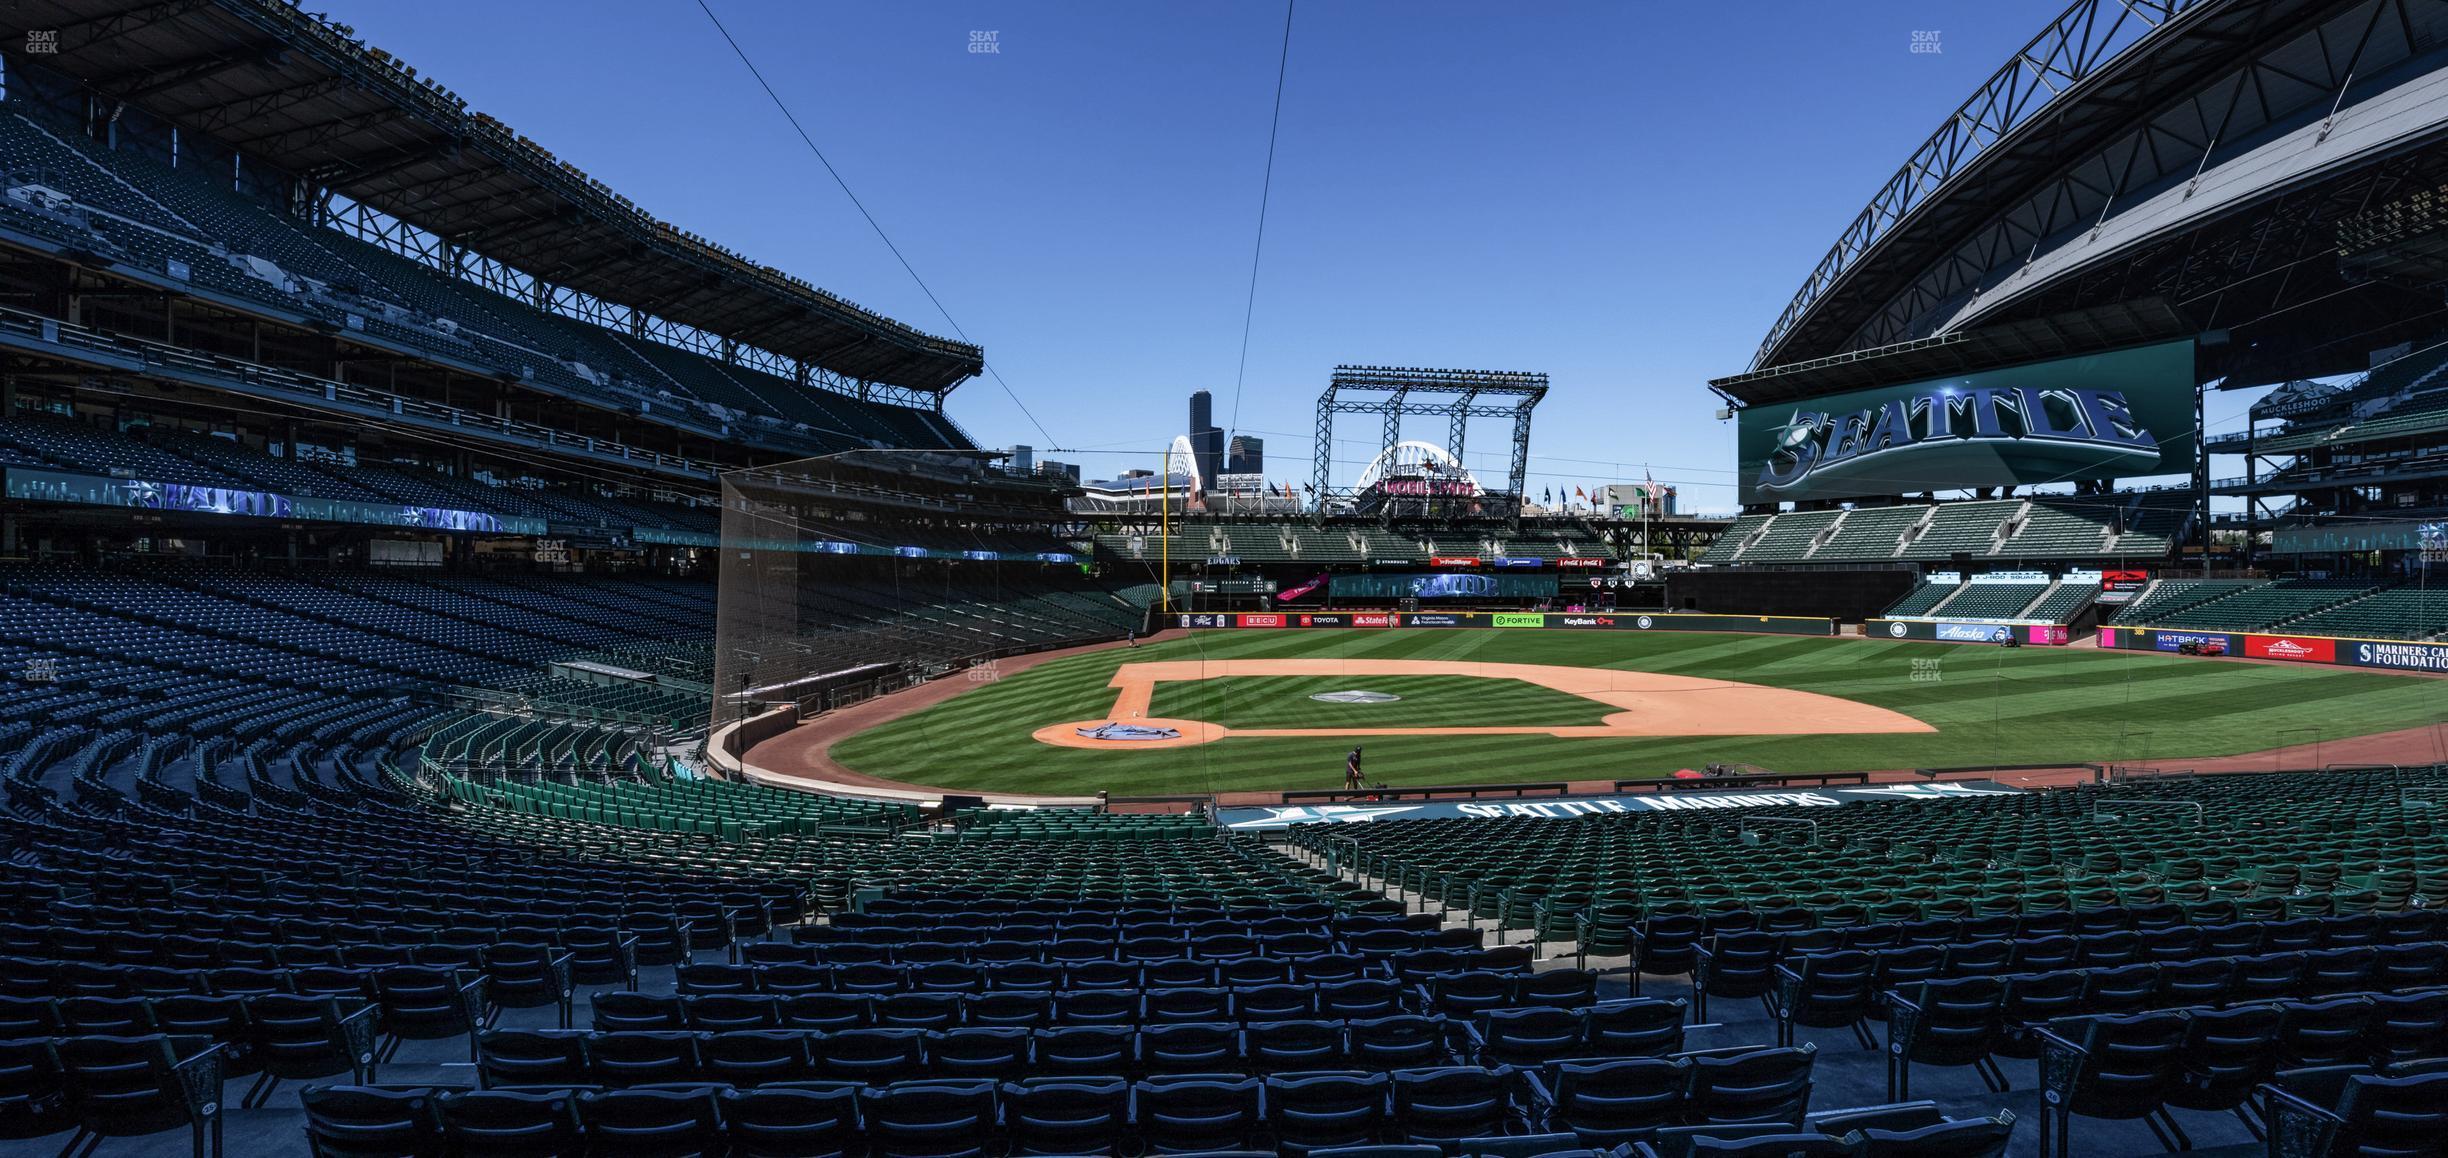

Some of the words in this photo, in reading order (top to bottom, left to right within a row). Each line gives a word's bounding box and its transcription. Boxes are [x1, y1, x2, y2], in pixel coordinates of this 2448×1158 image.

[2261, 397, 2330, 415] MUCKLESHOOT
[1757, 387, 2160, 490] SEATTLE
[1439, 481, 1476, 497] PARK
[1564, 618, 1596, 626] KeyBank
[1940, 626, 1984, 639] Alaska
[2158, 635, 2205, 644] HATBACK
[2376, 644, 2428, 657] MARINERS
[2376, 654, 2448, 669] FOUNDATIO
[1457, 799, 1629, 818] SEATTLE
[1635, 792, 1840, 811] MARINERS
